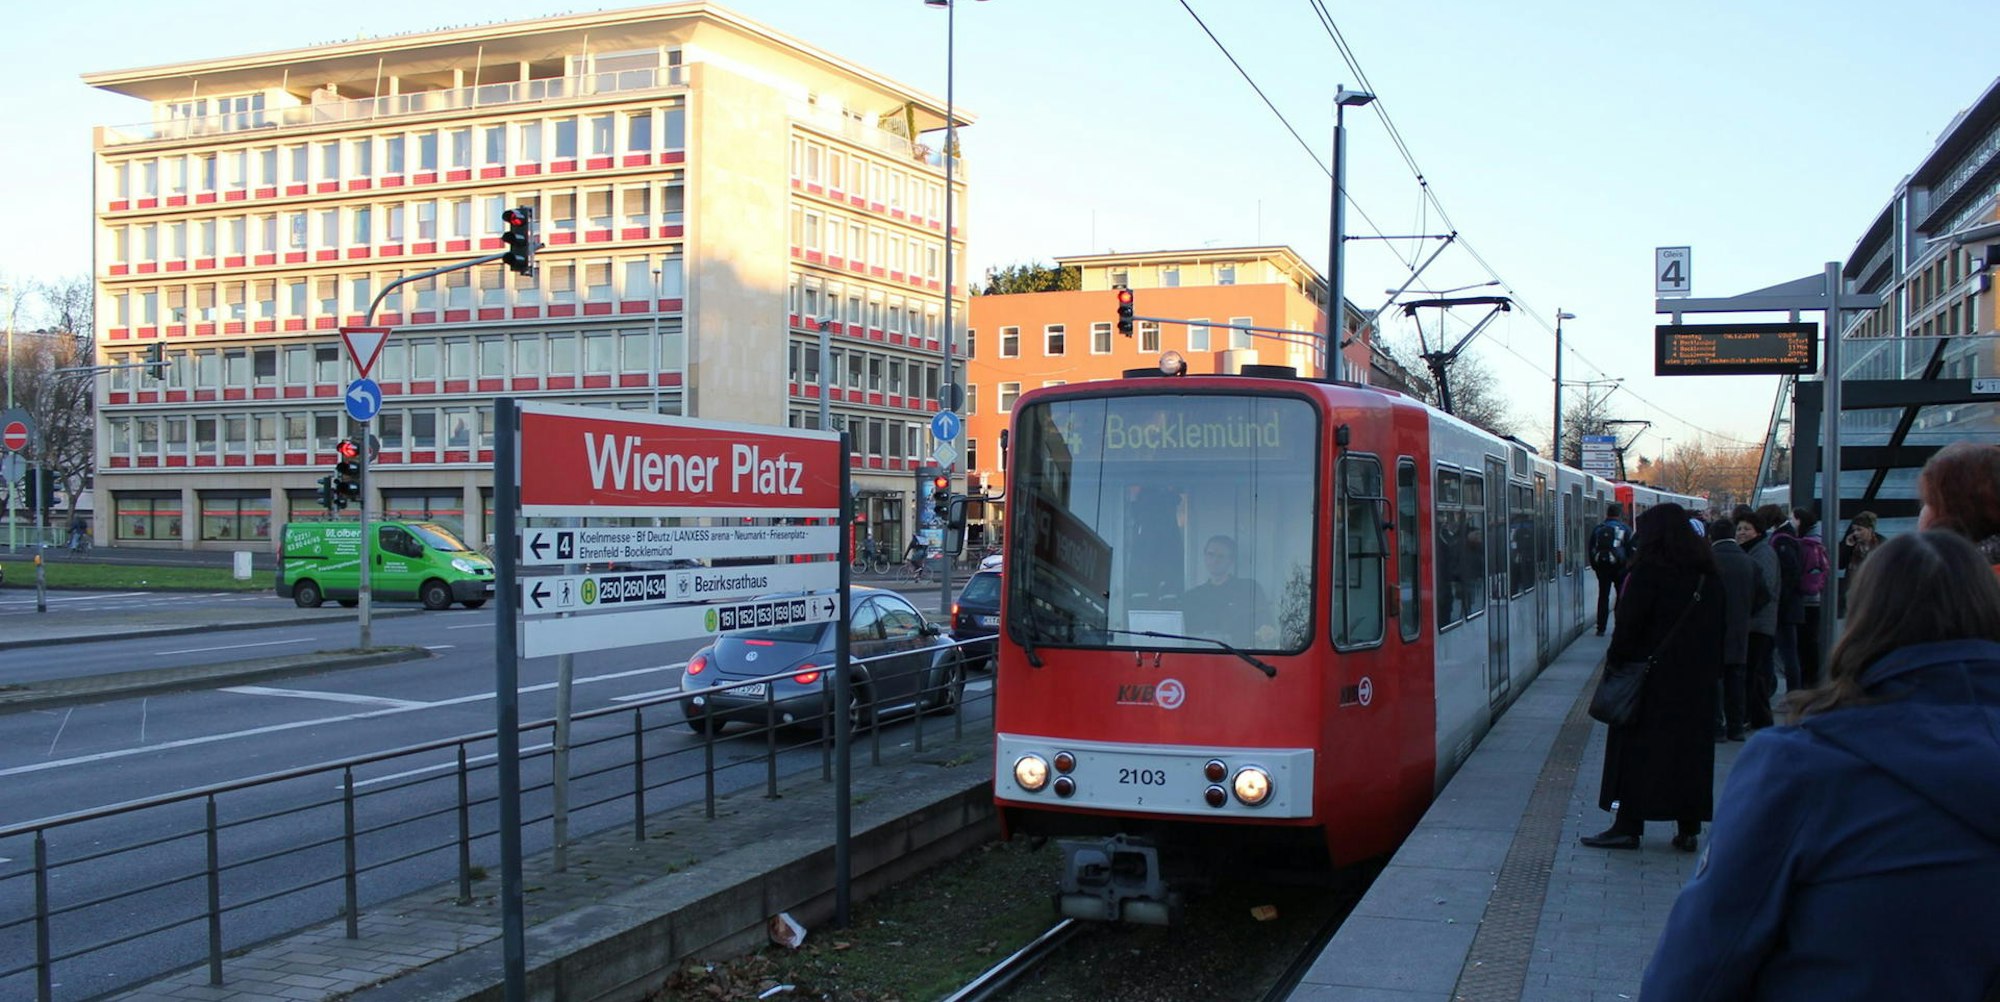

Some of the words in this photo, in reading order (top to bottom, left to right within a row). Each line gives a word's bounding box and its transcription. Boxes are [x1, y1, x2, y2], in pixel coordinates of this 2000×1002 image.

[1661, 260, 1685, 287] 4
[1106, 411, 1280, 449] Bocklemünd
[584, 432, 719, 492] Wiener
[732, 443, 803, 495] Platz
[559, 535, 571, 555] 4
[580, 531, 631, 543] Koelnmesse
[637, 530, 646, 542] Bf
[647, 530, 709, 542] Deutz/LANXESS
[711, 532, 730, 541] arena
[734, 530, 767, 540] Neumarkt
[580, 546, 619, 559] Ehrenfeld
[625, 545, 673, 557] Bocklemünd
[601, 581, 621, 599] 250
[624, 579, 644, 597] 260
[647, 577, 665, 595] 434
[695, 573, 767, 592] Bezirksrathaus
[721, 611, 735, 627] 151
[739, 609, 753, 625] 152
[757, 607, 772, 622] 153
[774, 606, 789, 620] 159
[791, 604, 805, 619] 190
[1117, 684, 1156, 703] KVB
[1119, 768, 1166, 786] 2103
[1137, 796, 1143, 805] 2
